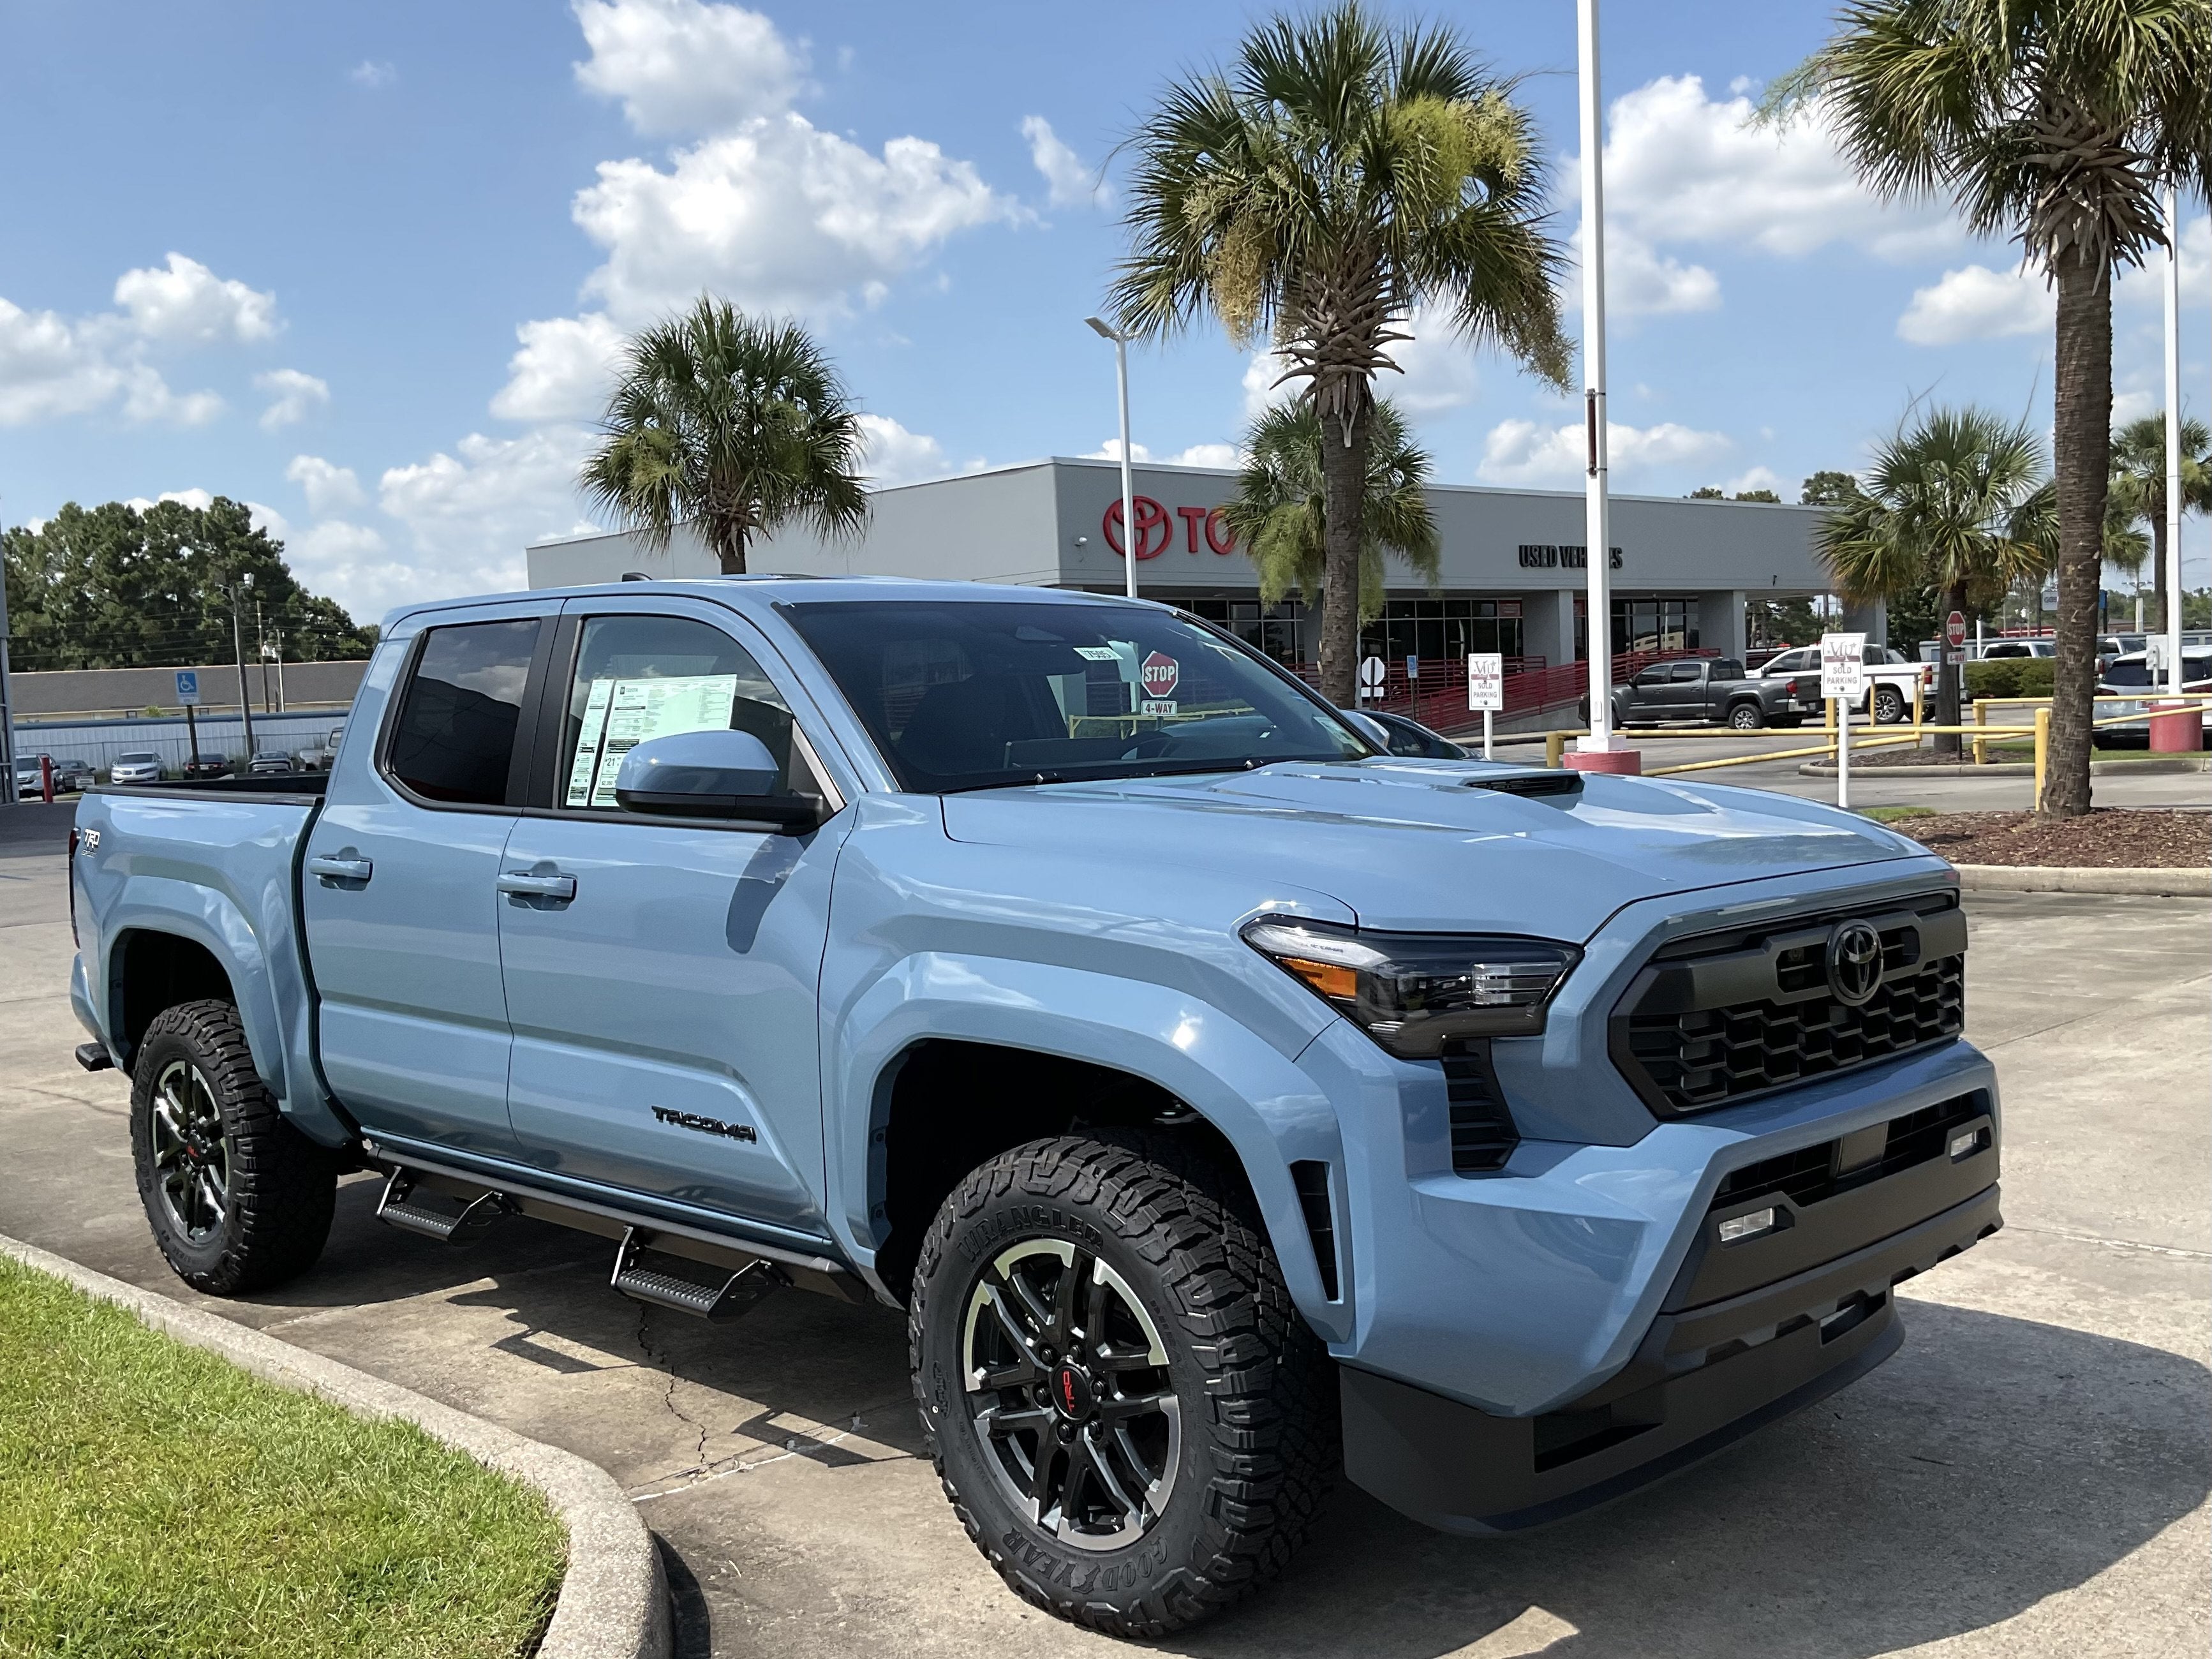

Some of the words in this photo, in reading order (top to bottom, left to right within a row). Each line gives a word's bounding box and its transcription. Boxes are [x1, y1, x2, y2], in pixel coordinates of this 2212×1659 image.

[1518, 545, 1558, 568] USED
[1559, 546, 1623, 569] VEHES
[1948, 623, 1964, 636] STOP
[1949, 653, 1965, 662] 4-WAY
[1145, 665, 1175, 682] STOP
[1832, 666, 1852, 674] SOLD
[1827, 676, 1858, 685] PARKING
[1145, 703, 1173, 714] 4-WAY
[84, 828, 101, 849] TRD
[651, 1105, 757, 1145] TACOMA
[956, 1204, 1104, 1263] WRANGLER
[1063, 1371, 1075, 1413] TRD
[1002, 1526, 1168, 1594] GOODYEAR
